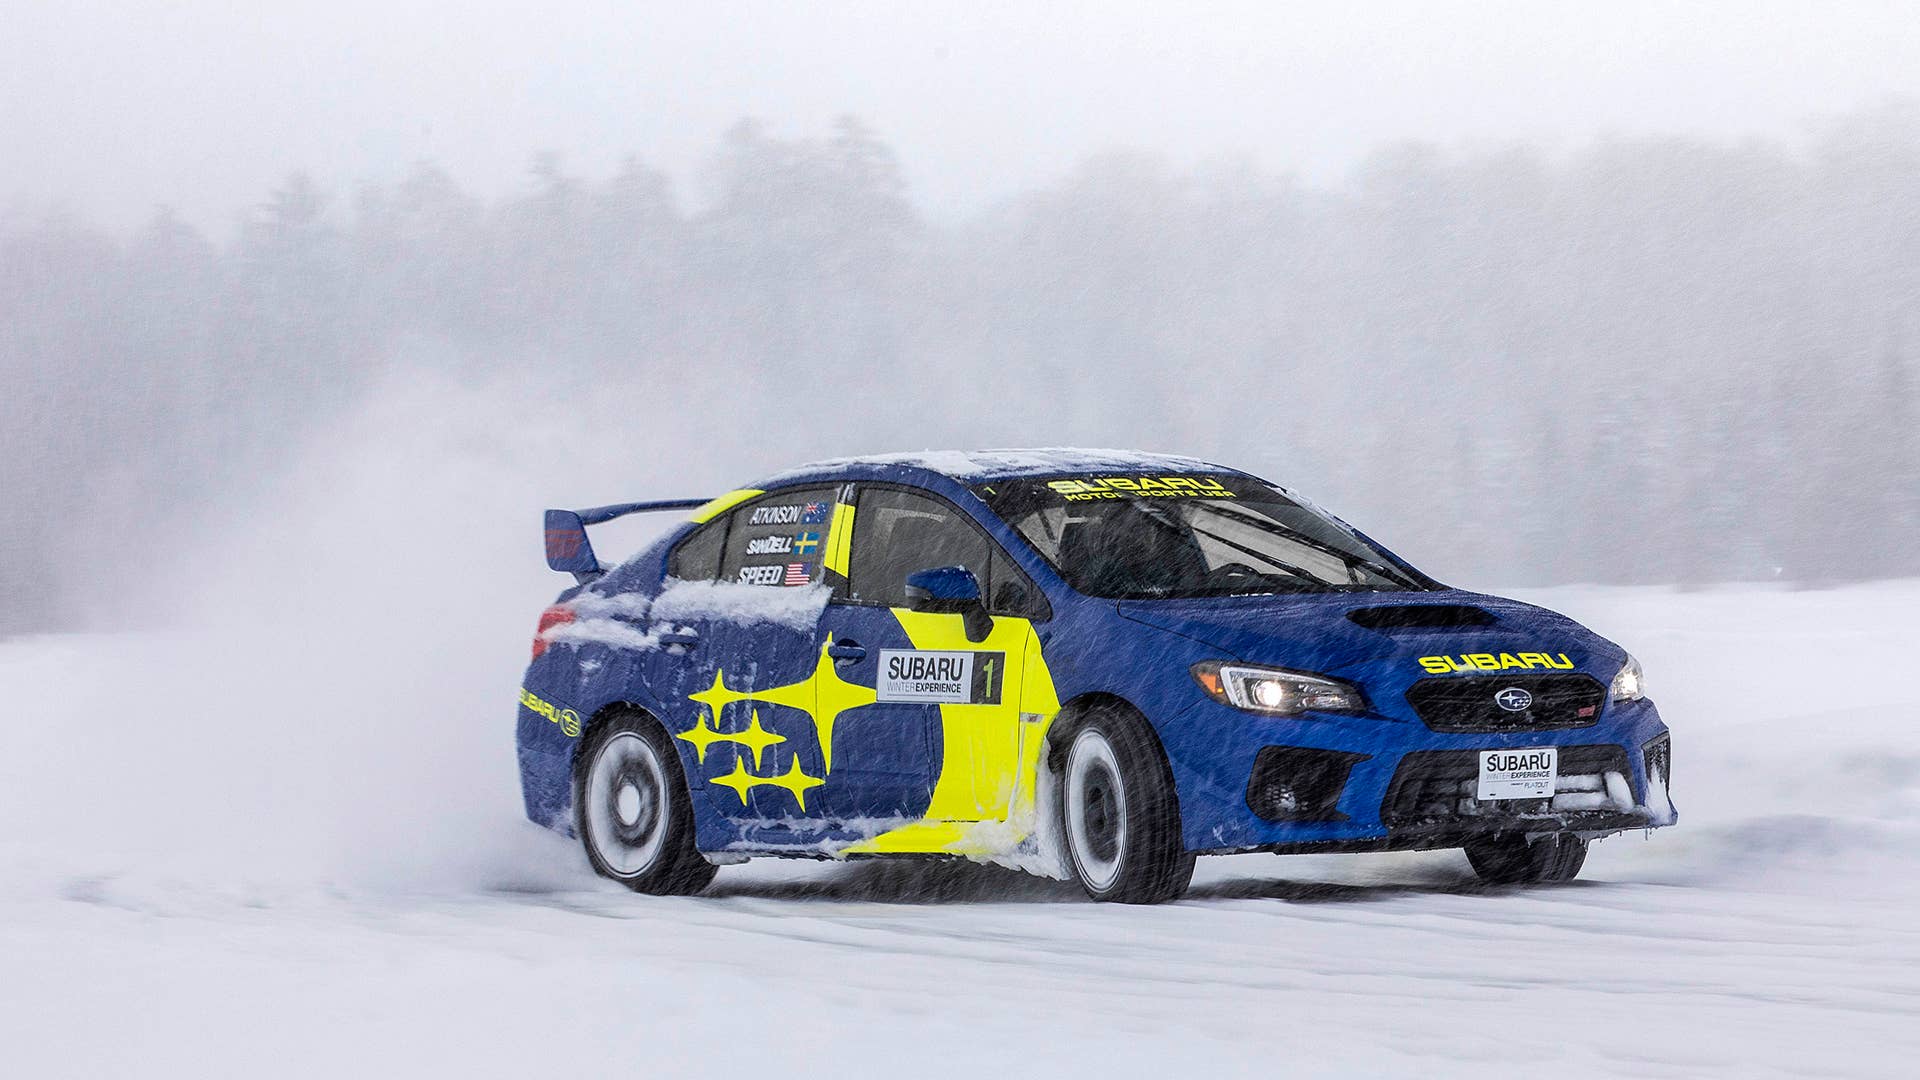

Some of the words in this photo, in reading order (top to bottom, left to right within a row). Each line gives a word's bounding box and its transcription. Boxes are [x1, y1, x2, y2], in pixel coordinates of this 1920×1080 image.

[1048, 477, 1225, 494] SUBARU
[749, 505, 802, 525] ATKINSON
[736, 565, 783, 585] SPEED
[1418, 652, 1575, 674] SUBARU
[888, 656, 964, 681] SUBARU
[983, 658, 994, 698] 1
[1487, 753, 1551, 772] SUBARU
